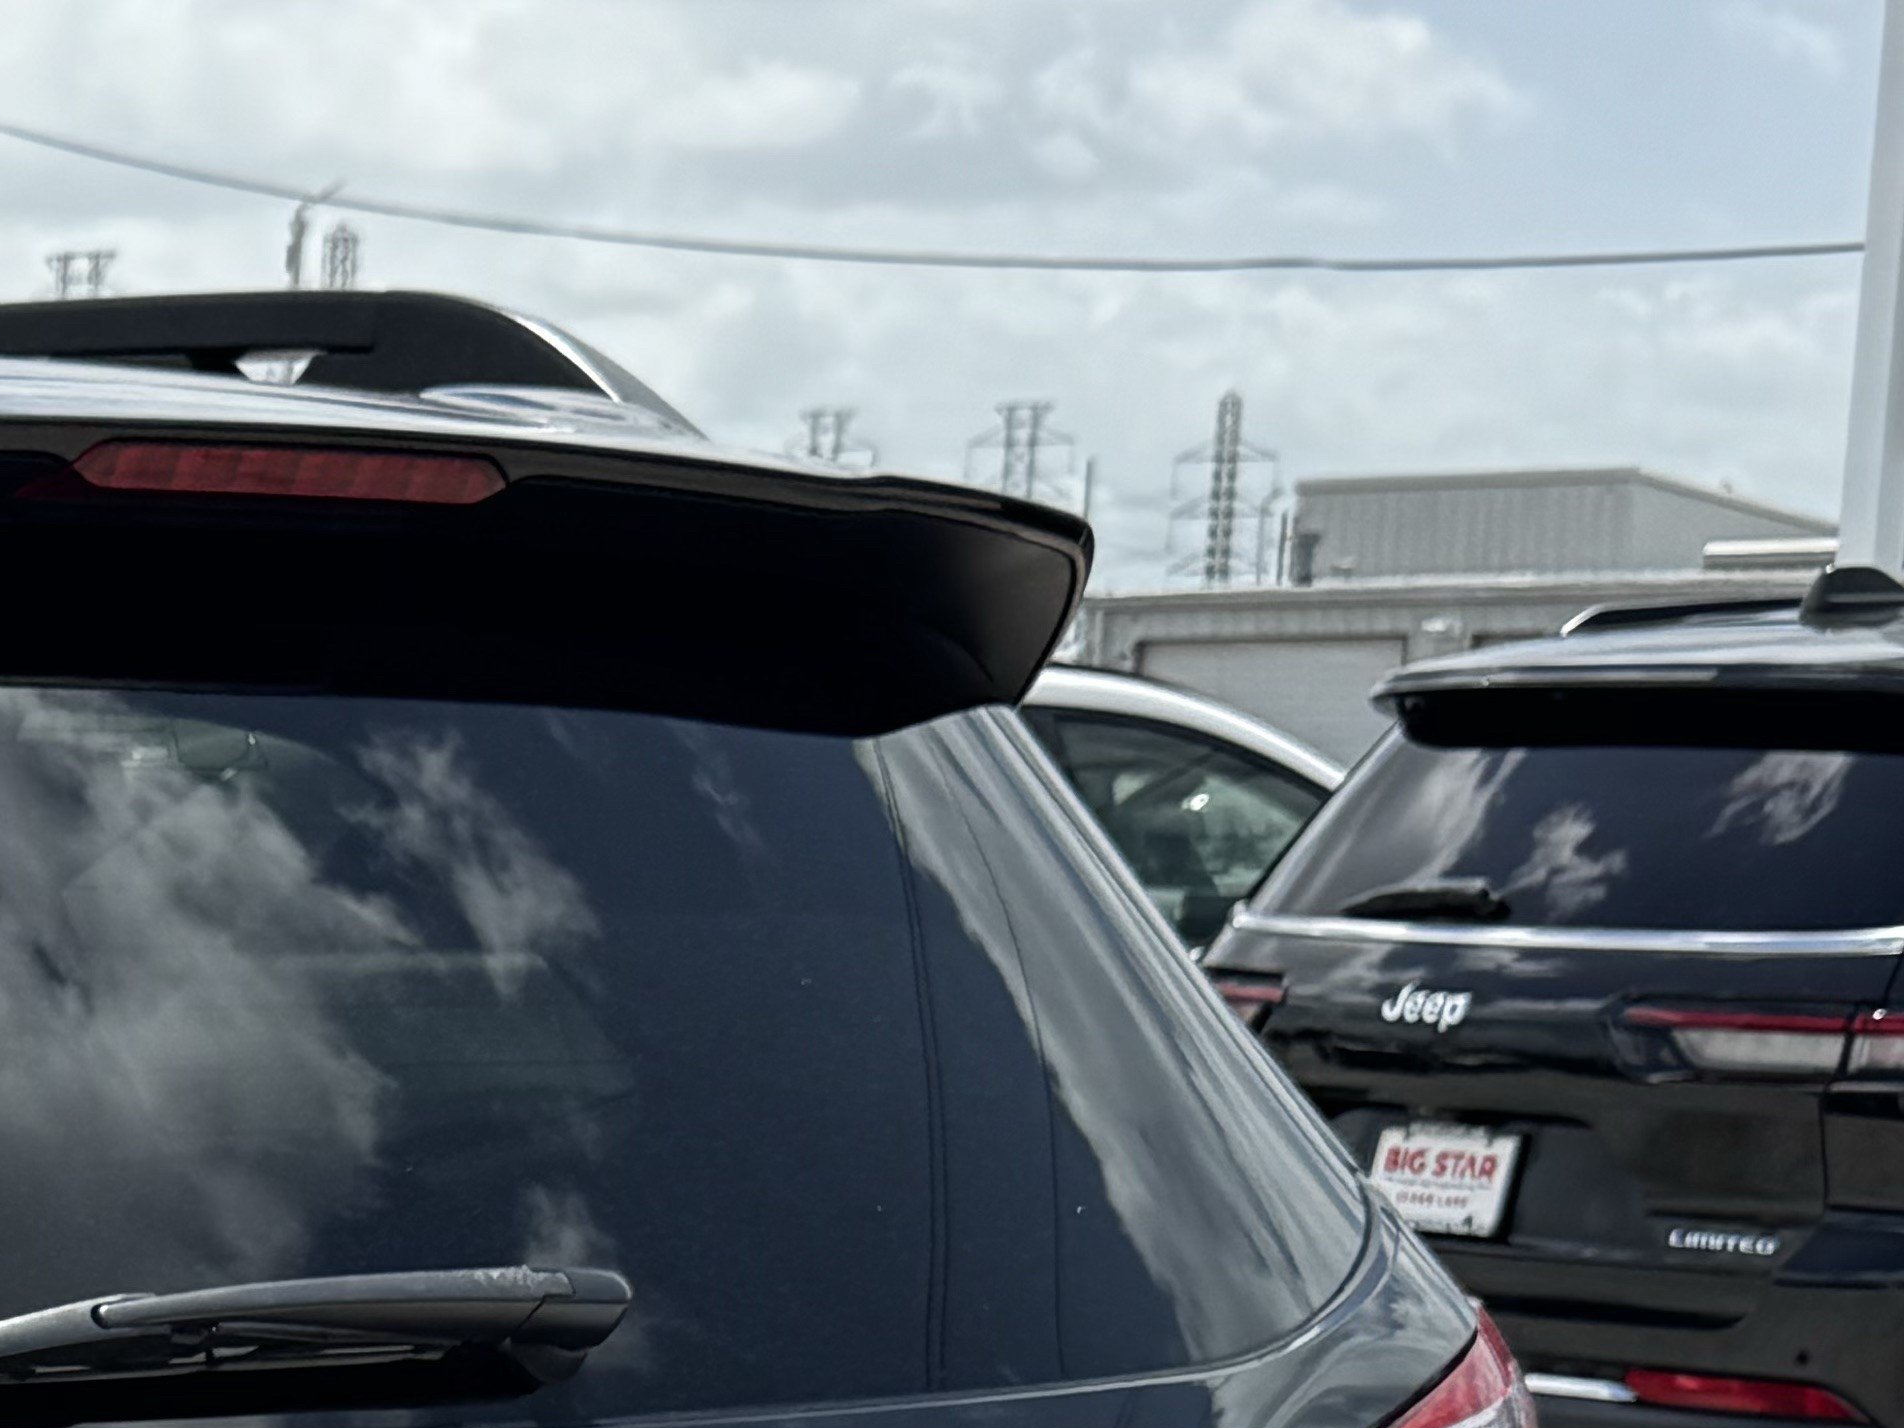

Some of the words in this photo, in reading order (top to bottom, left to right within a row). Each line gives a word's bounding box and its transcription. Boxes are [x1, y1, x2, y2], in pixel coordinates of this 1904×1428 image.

[1381, 979, 1473, 1033] Jeep
[1384, 1147, 1426, 1175] BIG
[1432, 1151, 1498, 1181] STAR
